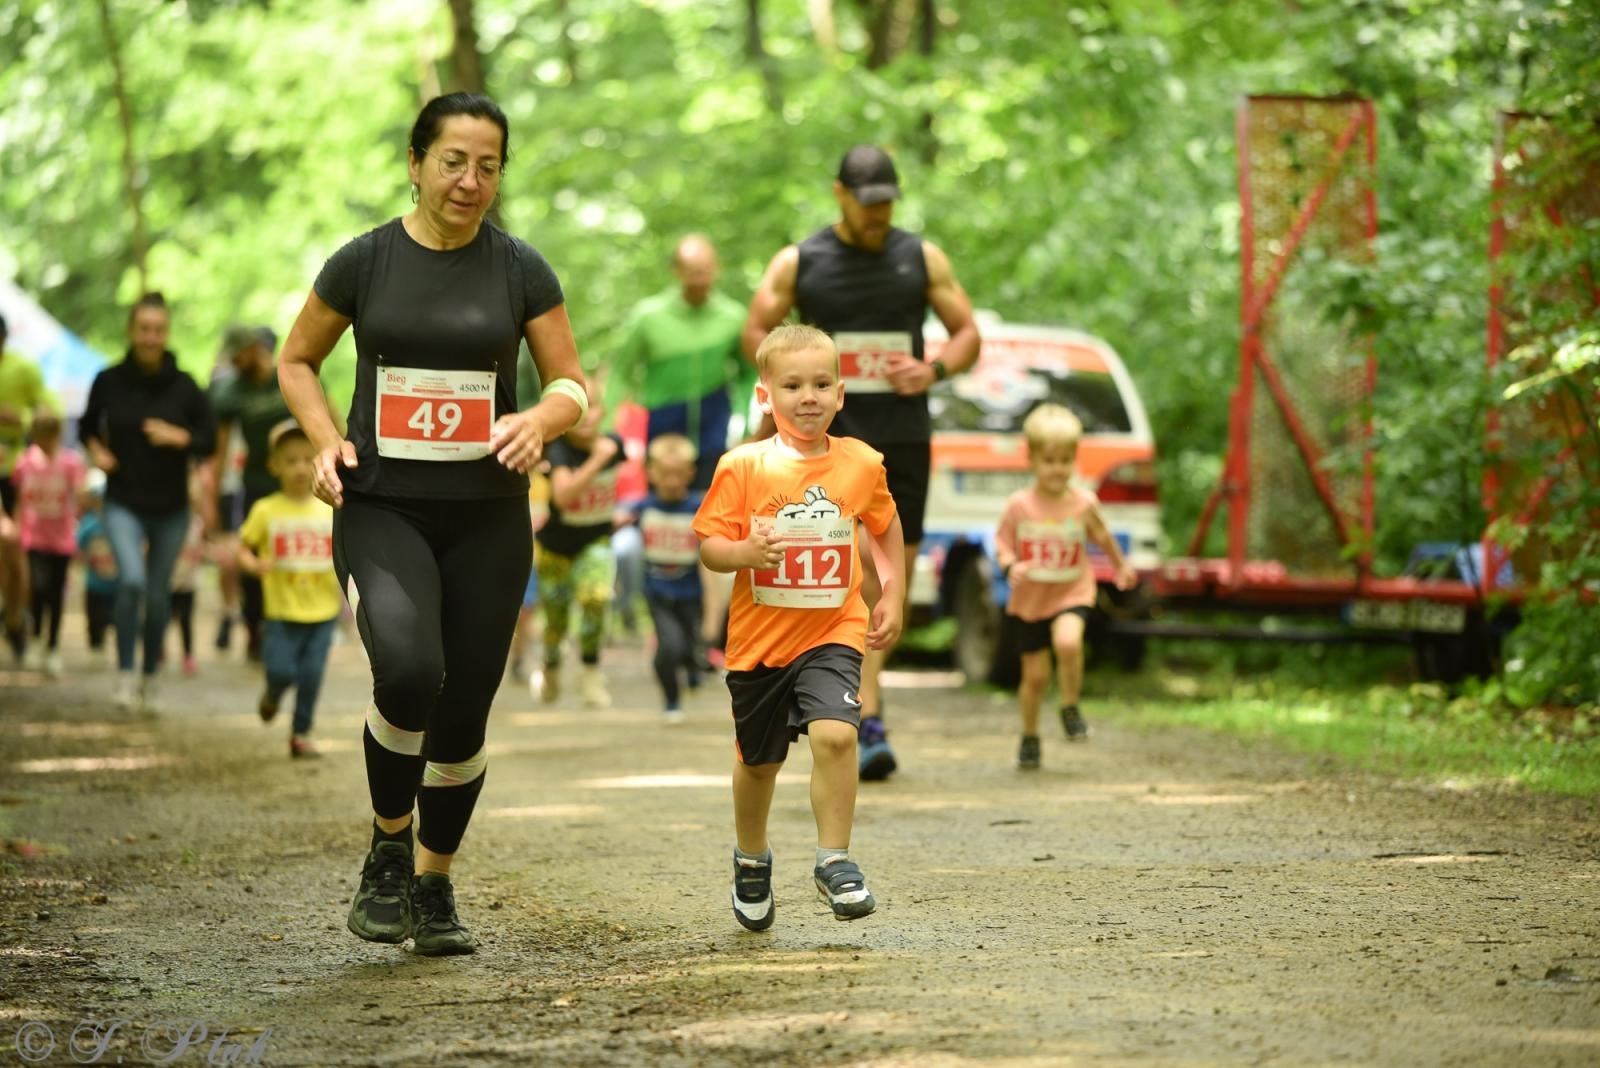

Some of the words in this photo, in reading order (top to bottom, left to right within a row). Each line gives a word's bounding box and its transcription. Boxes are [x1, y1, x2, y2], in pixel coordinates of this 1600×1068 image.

[386, 373, 406, 385] Bieg
[459, 384, 480, 393] 4500
[481, 384, 490, 393] M
[407, 400, 463, 439] 49
[828, 530, 844, 539] 4500
[772, 548, 842, 586] 112
